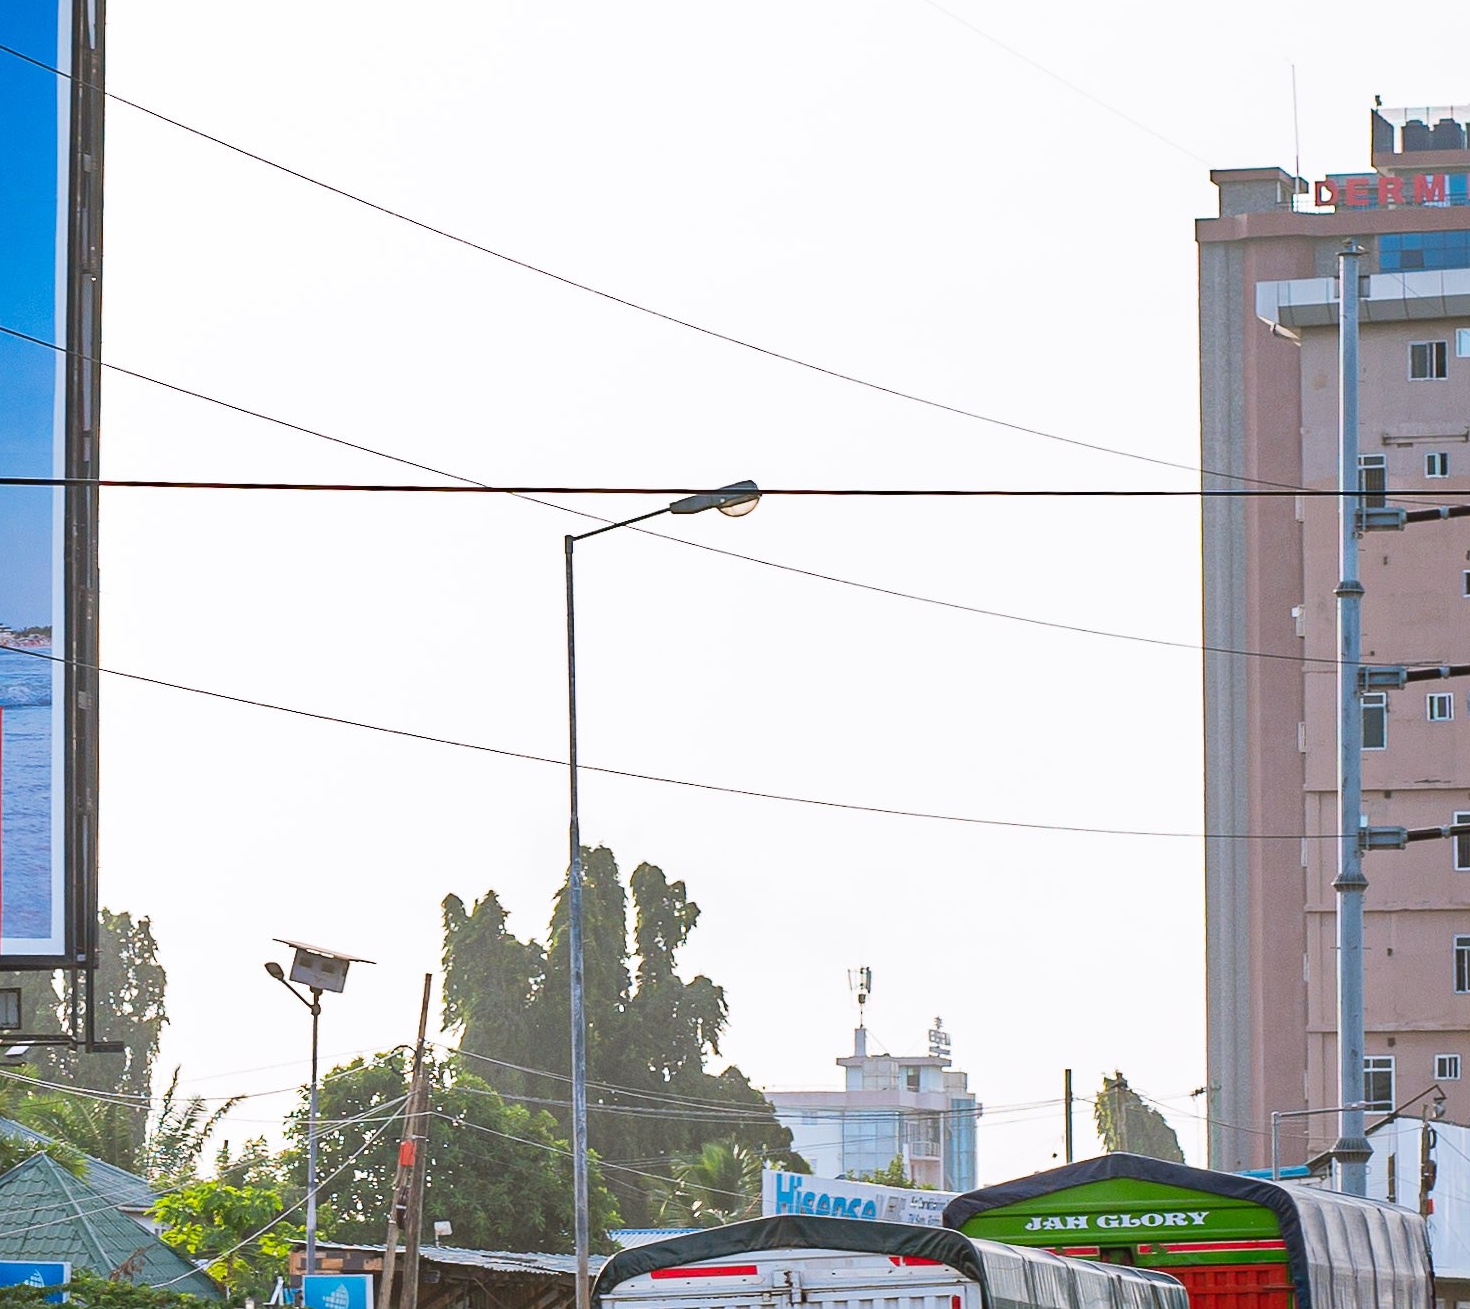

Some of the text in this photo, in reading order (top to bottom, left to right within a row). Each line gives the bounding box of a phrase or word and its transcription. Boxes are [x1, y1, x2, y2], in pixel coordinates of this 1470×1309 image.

[1315, 173, 1447, 207] DERM
[1025, 1211, 1209, 1231] JAH GLORY
